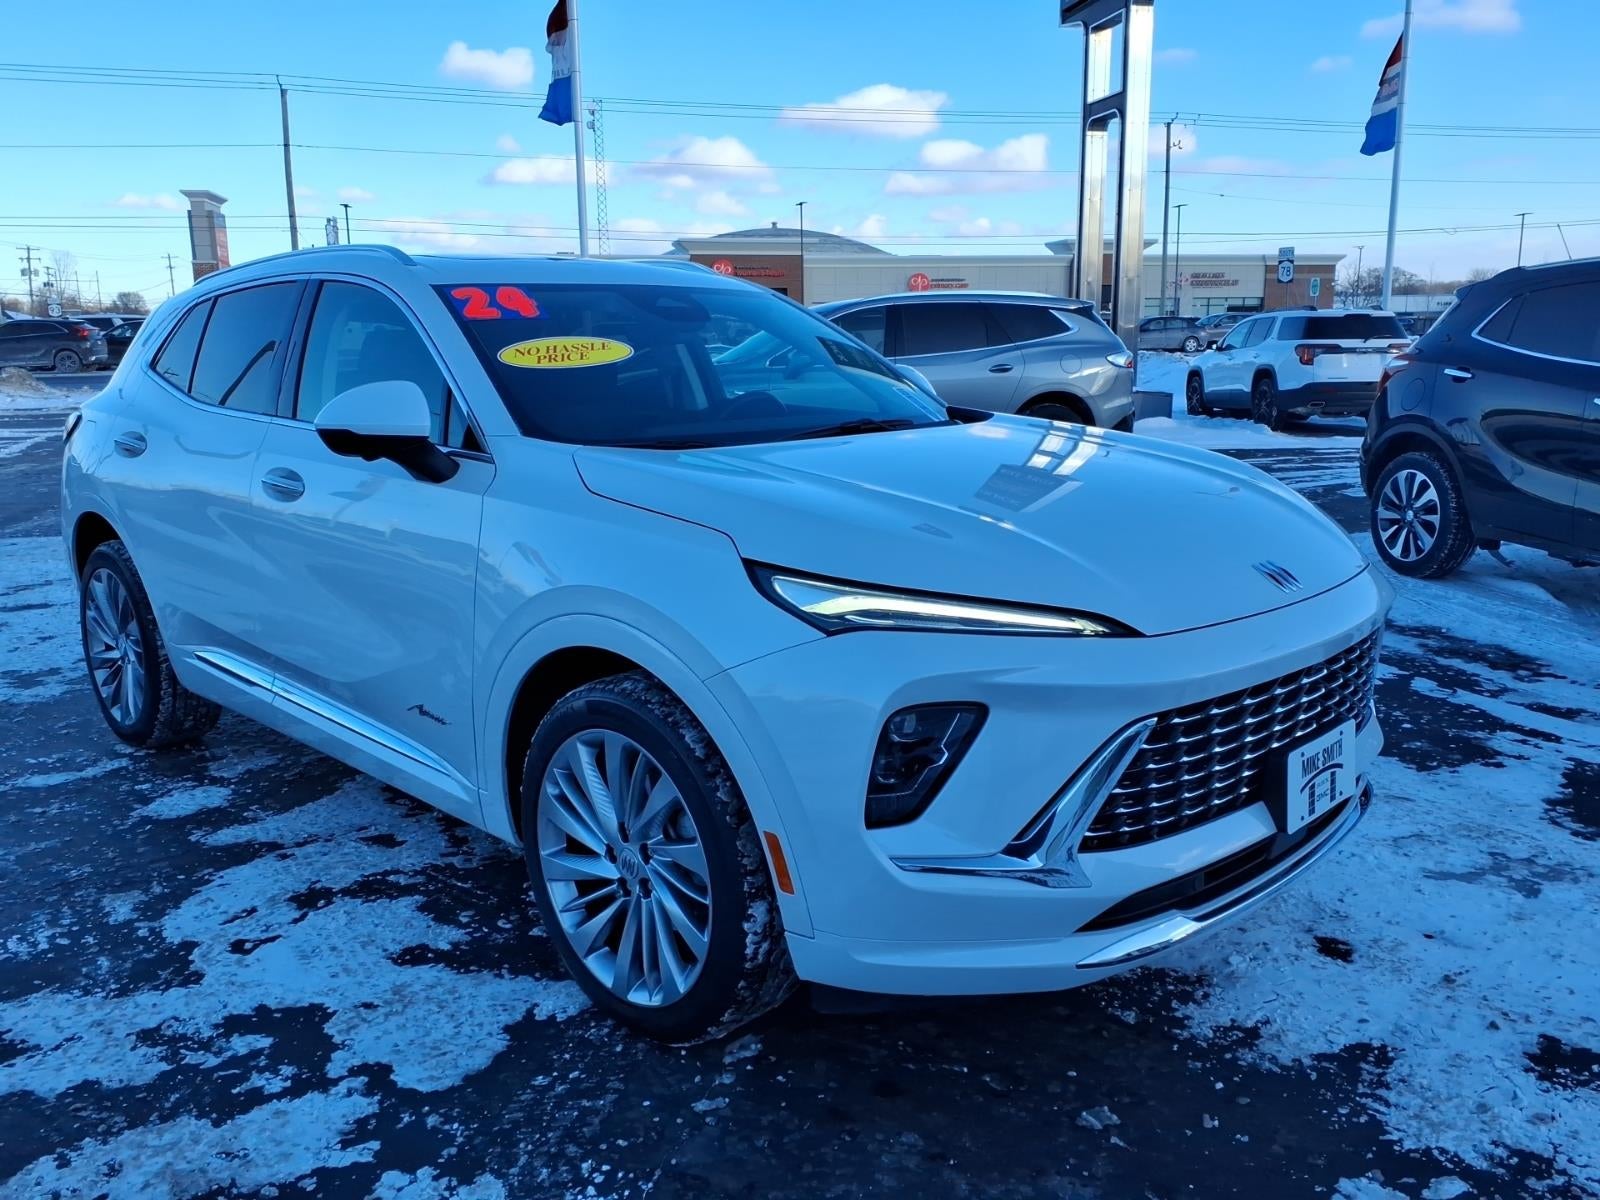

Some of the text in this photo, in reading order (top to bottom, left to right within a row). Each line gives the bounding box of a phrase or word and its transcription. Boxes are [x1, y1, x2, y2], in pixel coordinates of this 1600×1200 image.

[1280, 266, 1291, 277] 78
[514, 342, 612, 359] NO HASSLE
[536, 351, 591, 365] PRICE
[1302, 738, 1342, 779] MIKE SMITH
